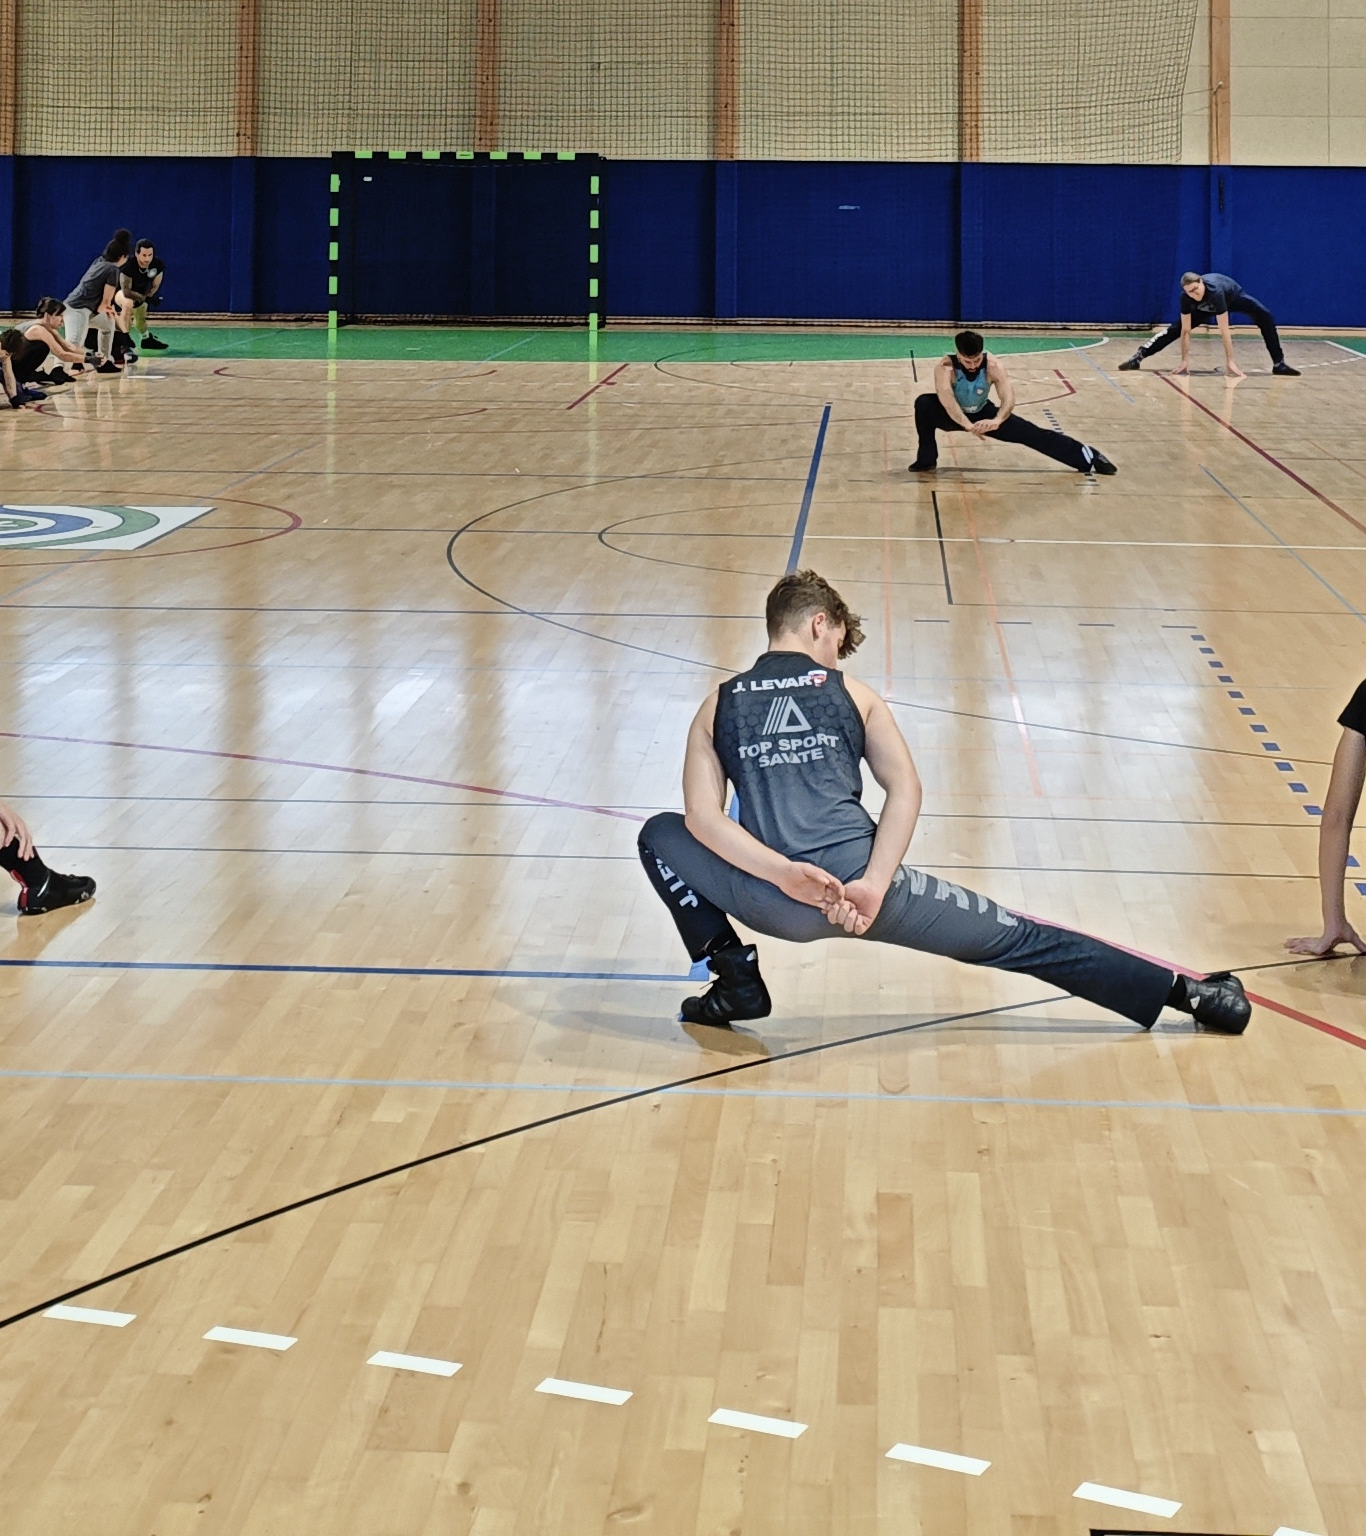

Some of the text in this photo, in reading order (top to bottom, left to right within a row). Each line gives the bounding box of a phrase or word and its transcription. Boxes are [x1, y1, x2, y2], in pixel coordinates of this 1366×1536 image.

[732, 681, 747, 694] J.
[738, 732, 840, 759] TOP SPORT
[758, 747, 825, 768] SAVATE
